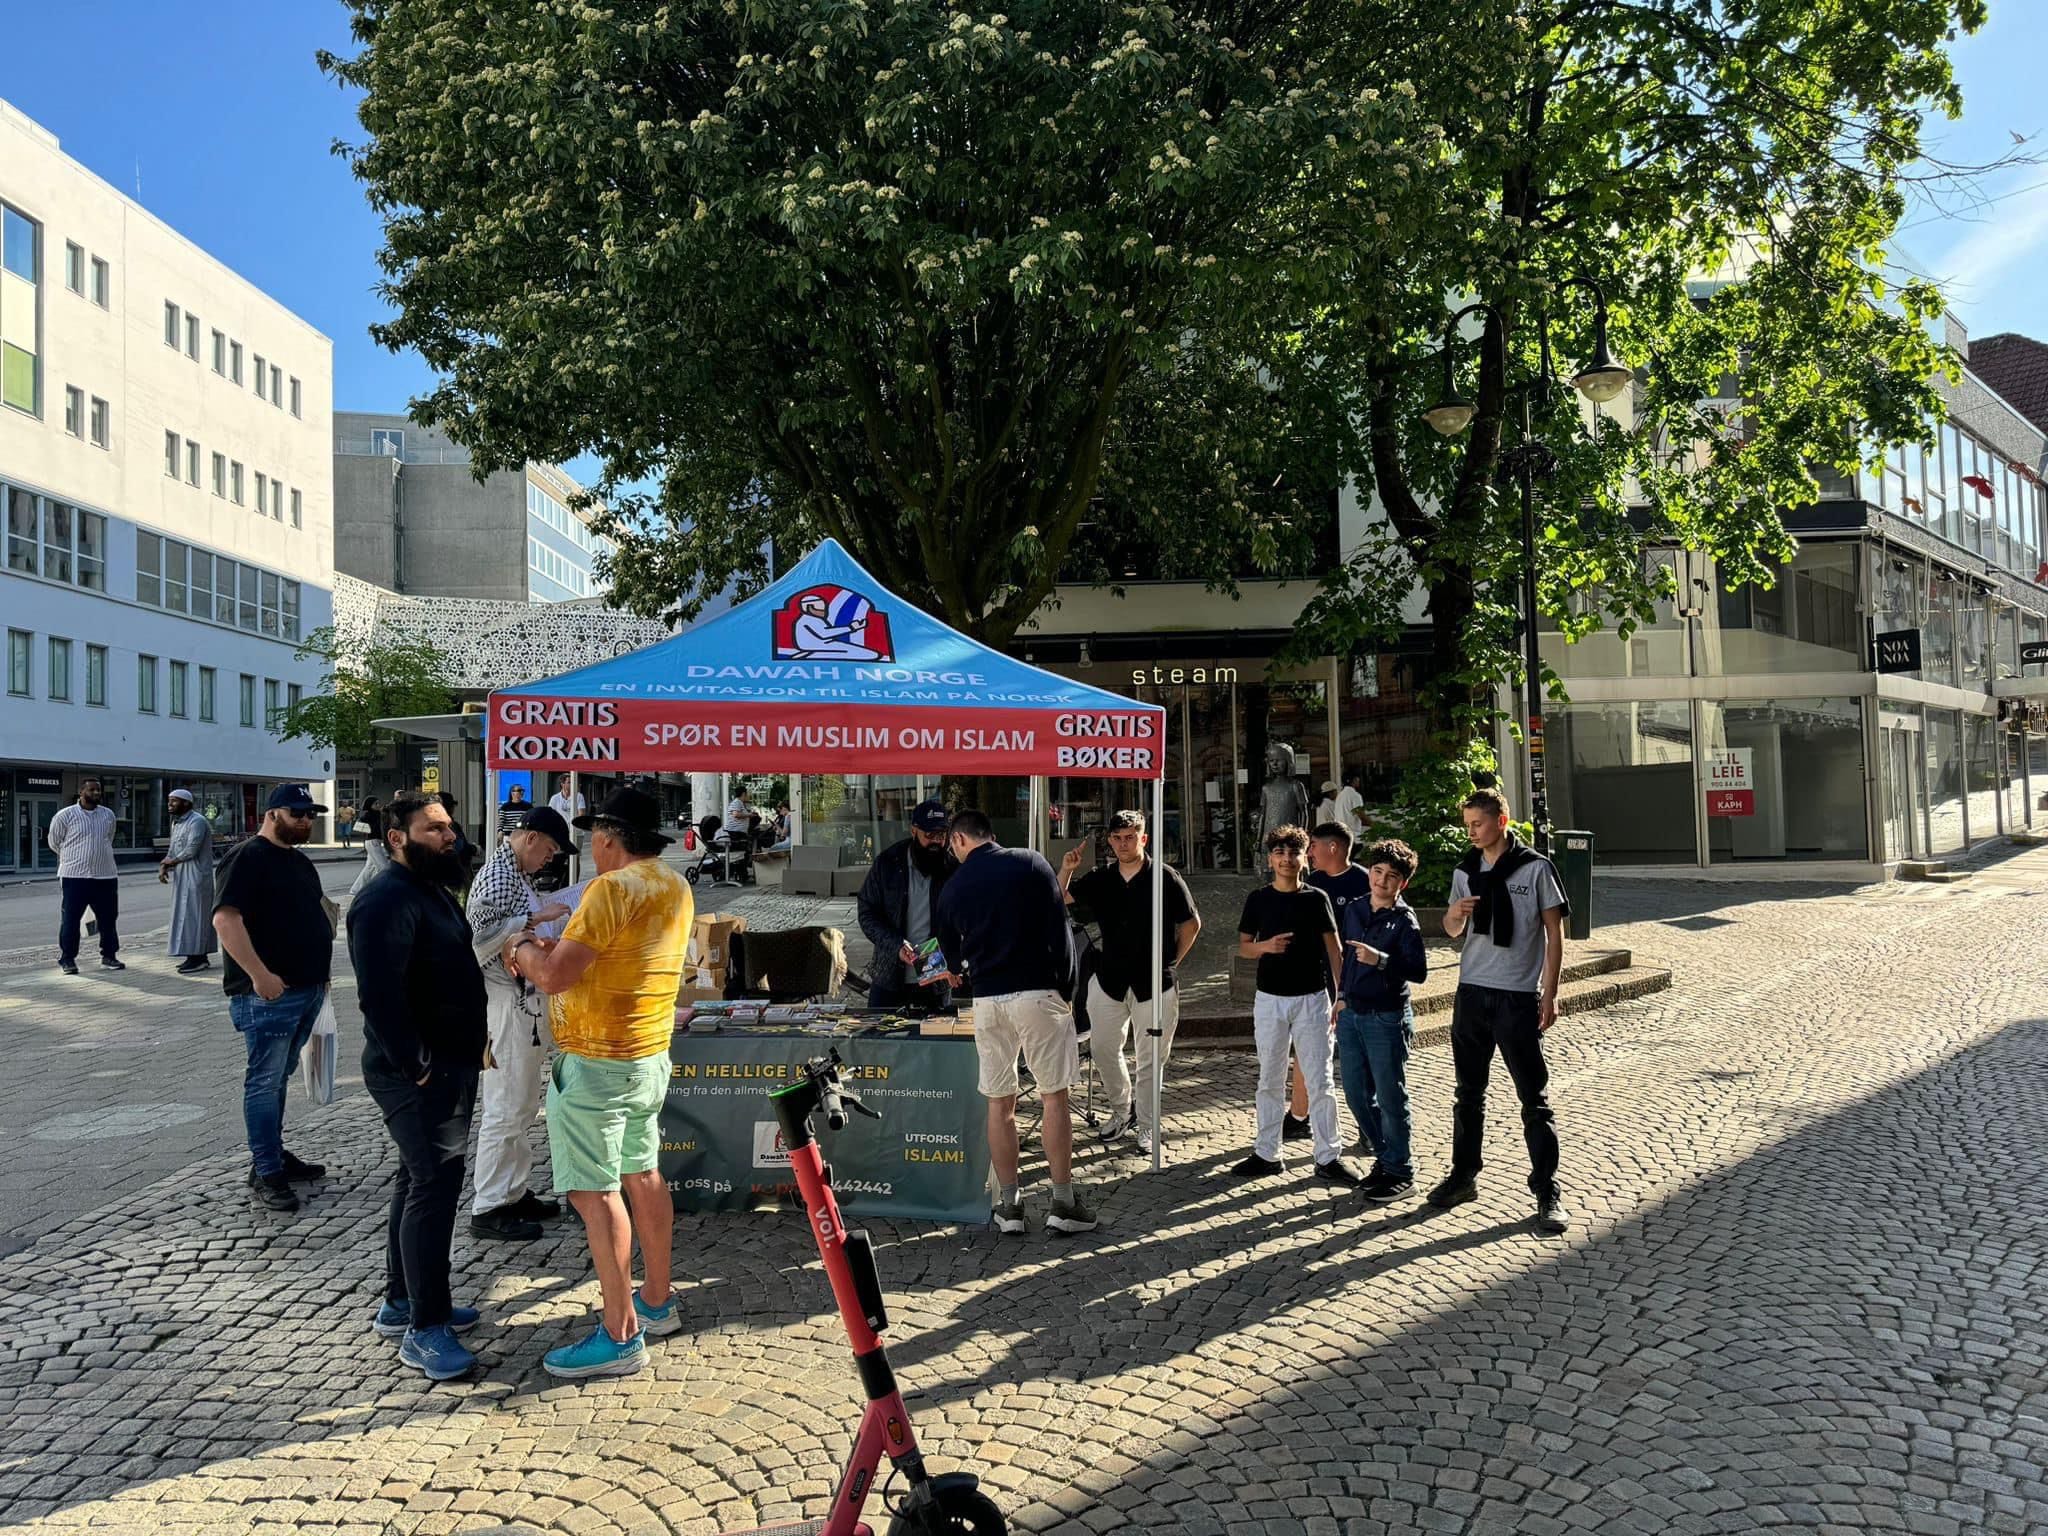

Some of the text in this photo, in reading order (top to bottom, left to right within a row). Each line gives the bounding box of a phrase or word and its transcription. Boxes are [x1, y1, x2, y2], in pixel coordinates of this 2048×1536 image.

[1883, 639, 1909, 652] NOA
[1883, 652, 1910, 665] NOA
[2022, 648, 2048, 659] Gli
[687, 665, 988, 686] DAWAH NORGE
[1132, 666, 1237, 685] steam
[600, 683, 1073, 704] EN INVITASJON TIL ISLAM PÅ NORSK
[500, 700, 618, 727] GRATIS
[1055, 713, 1155, 738] GRATIS
[643, 723, 1035, 751] SPØR EN MUSLIM OM ISLAM
[498, 735, 619, 761] KORAN
[1057, 746, 1153, 769] BØKER
[1712, 766, 1745, 779] LEIE
[28, 778, 59, 786] STARBUCKS
[1717, 801, 1743, 809] KAPH
[672, 1064, 697, 1077] EN
[705, 1064, 787, 1077] HELLIGE
[693, 1084, 708, 1095] fra
[710, 1085, 731, 1095] den
[734, 1085, 772, 1095] allmek
[863, 1087, 953, 1099] menneskeheten!
[905, 1133, 959, 1144] UTFORSK
[904, 1148, 965, 1163] ISLAM!
[684, 1178, 711, 1189] oss
[714, 1179, 732, 1193] på
